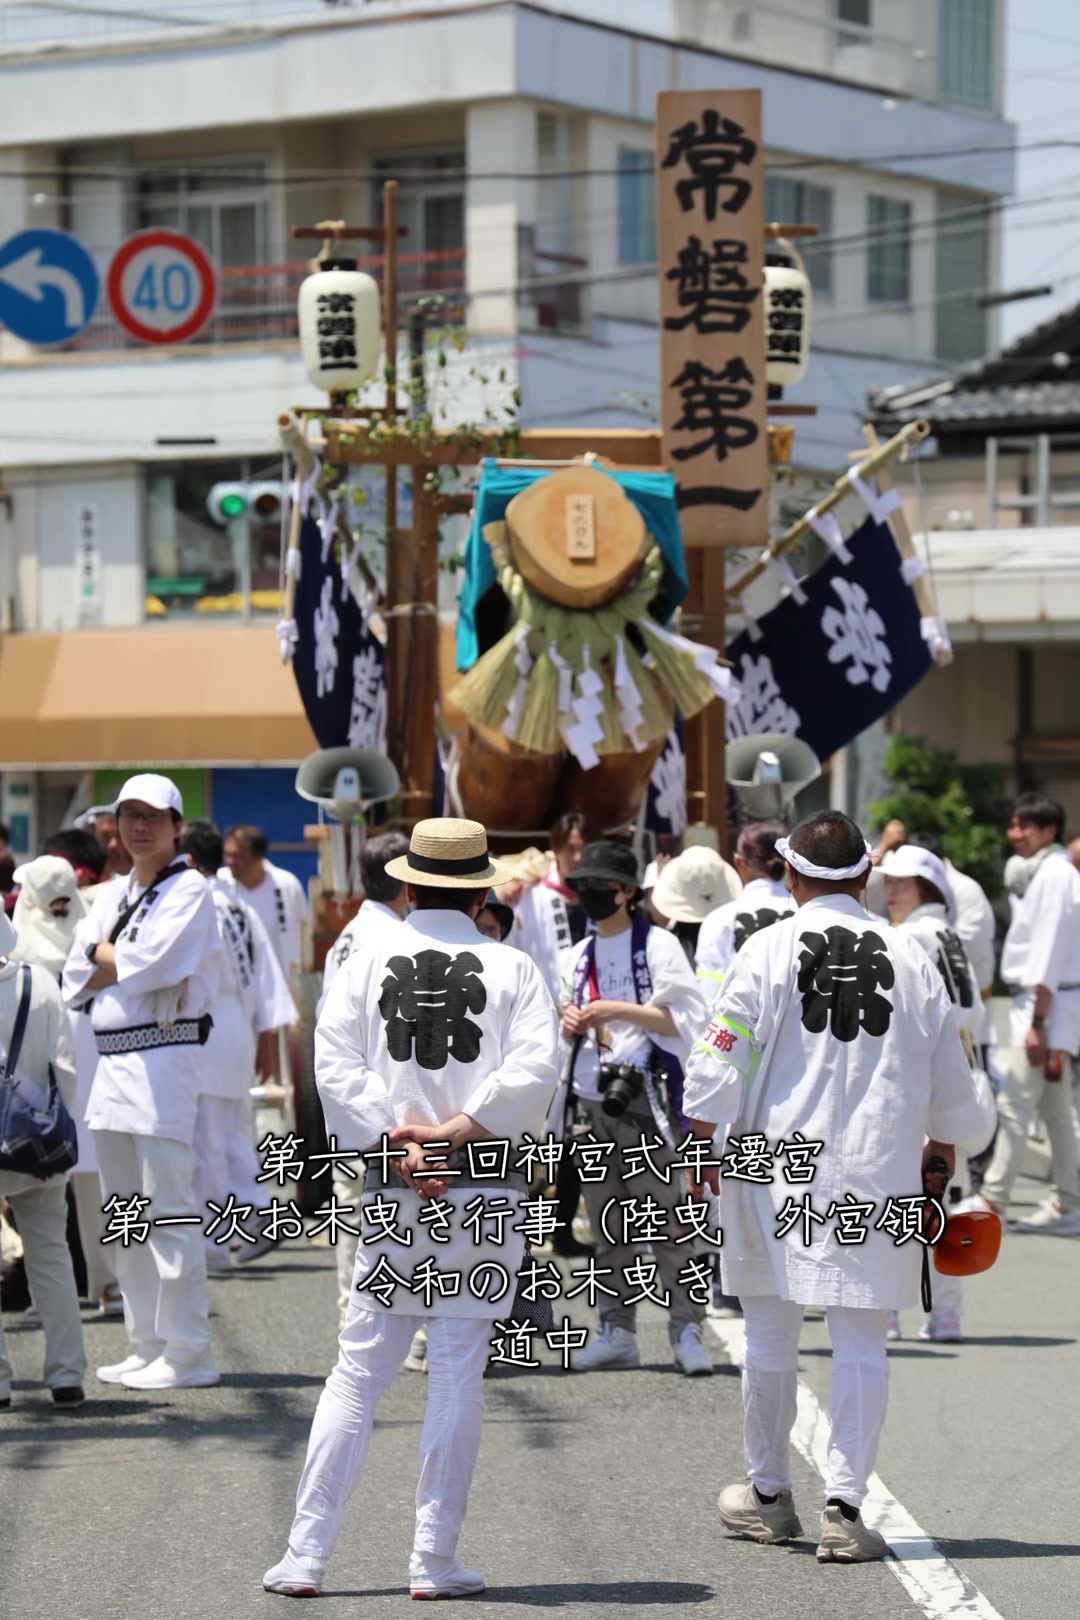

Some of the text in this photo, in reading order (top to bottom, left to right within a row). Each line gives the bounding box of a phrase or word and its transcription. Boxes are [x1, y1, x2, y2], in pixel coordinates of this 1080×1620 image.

[133, 263, 192, 312] 40
[662, 109, 762, 512] 常磐第一
[378, 949, 487, 1070] 常
[798, 925, 895, 1042] 常
